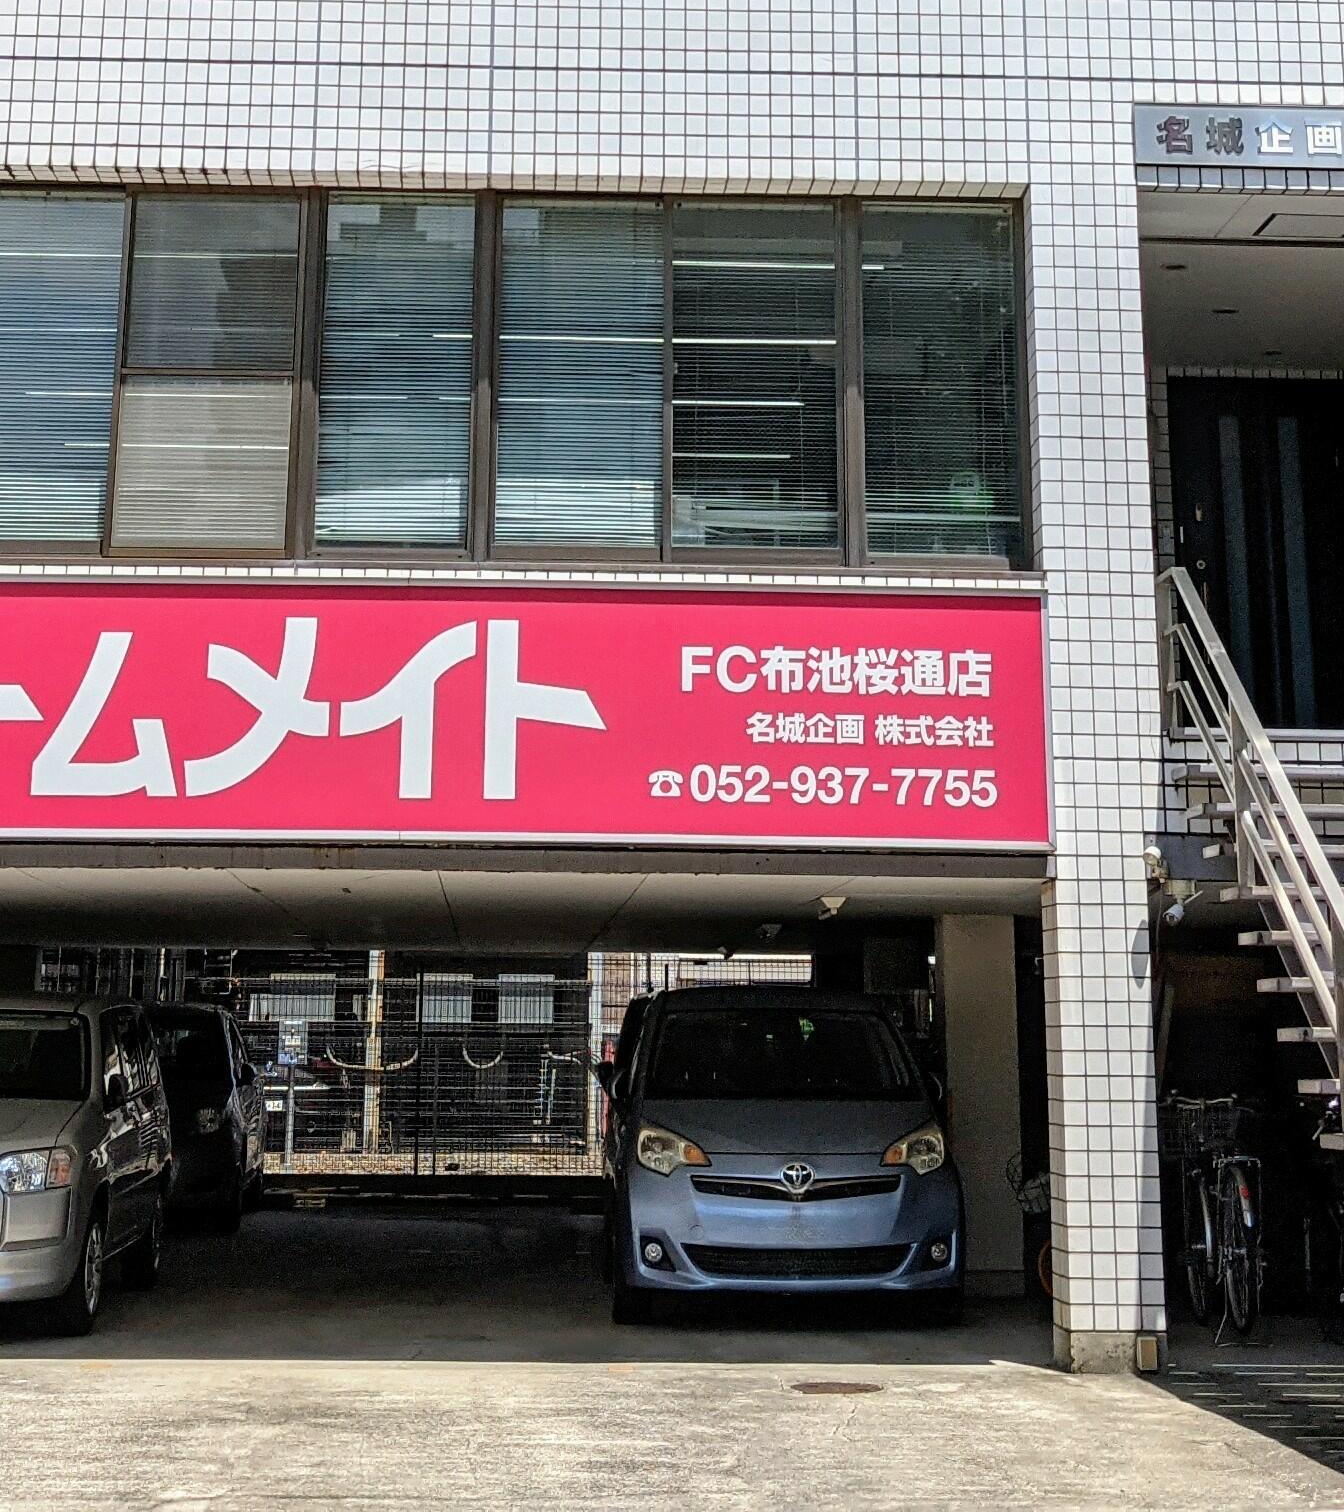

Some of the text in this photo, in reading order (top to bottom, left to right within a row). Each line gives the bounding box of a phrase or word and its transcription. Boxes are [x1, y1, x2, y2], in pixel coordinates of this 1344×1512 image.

[680, 645, 993, 698] FC布池桜通店
[745, 712, 995, 748] 名城企画 株式会社
[689, 764, 998, 808] 052-937-7755
